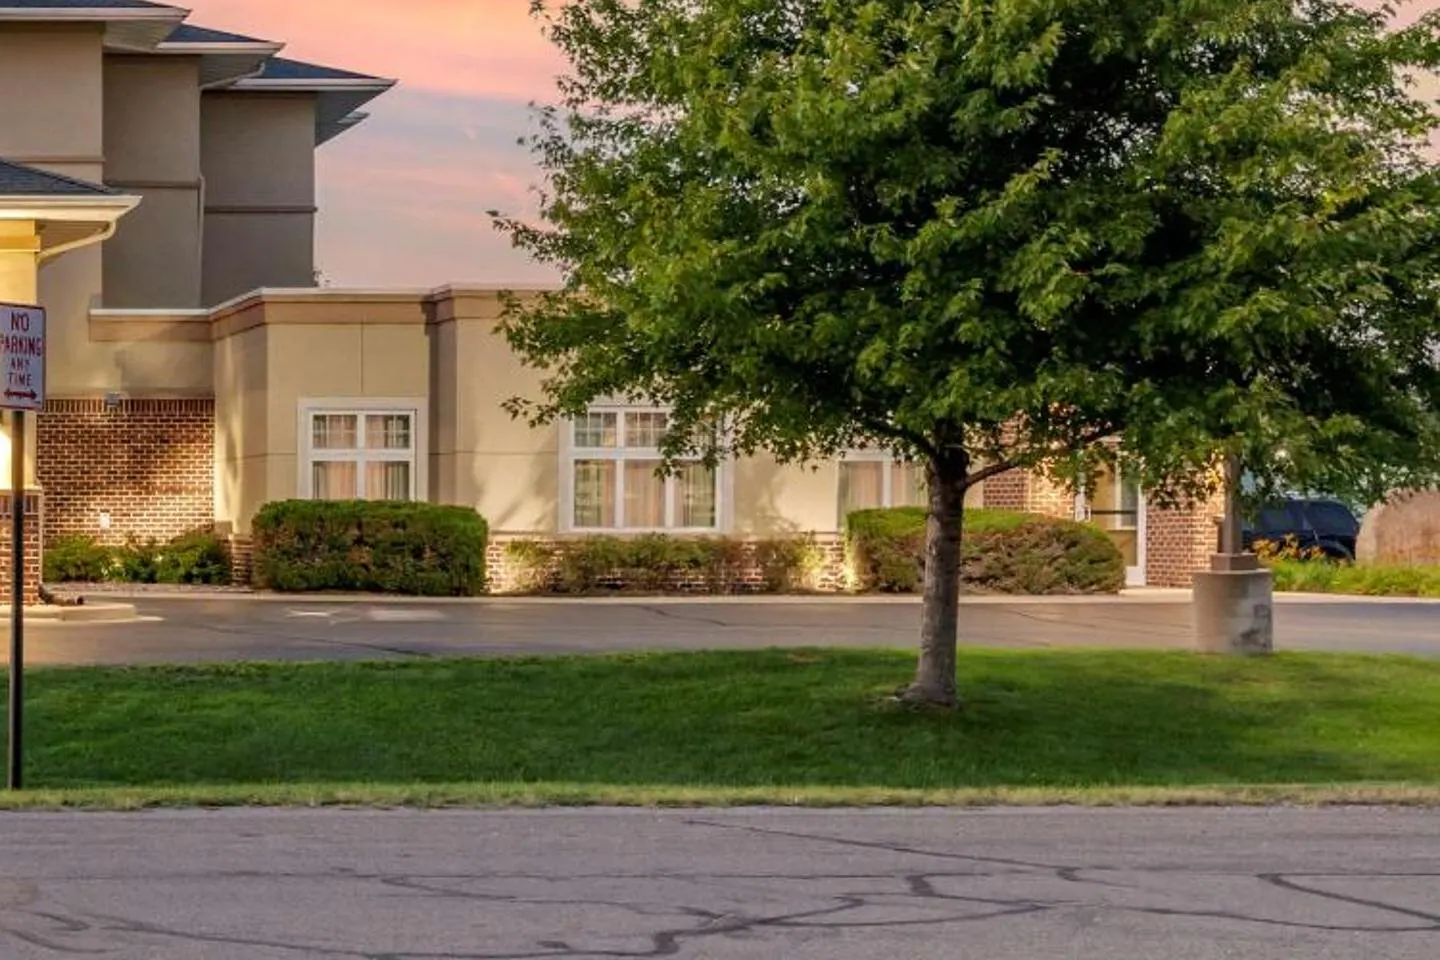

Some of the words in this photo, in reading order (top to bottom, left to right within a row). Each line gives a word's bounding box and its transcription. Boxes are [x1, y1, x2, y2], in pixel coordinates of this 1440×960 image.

[10, 312, 30, 332] NO
[10, 358, 30, 371] ANY
[8, 372, 32, 386] TIME
